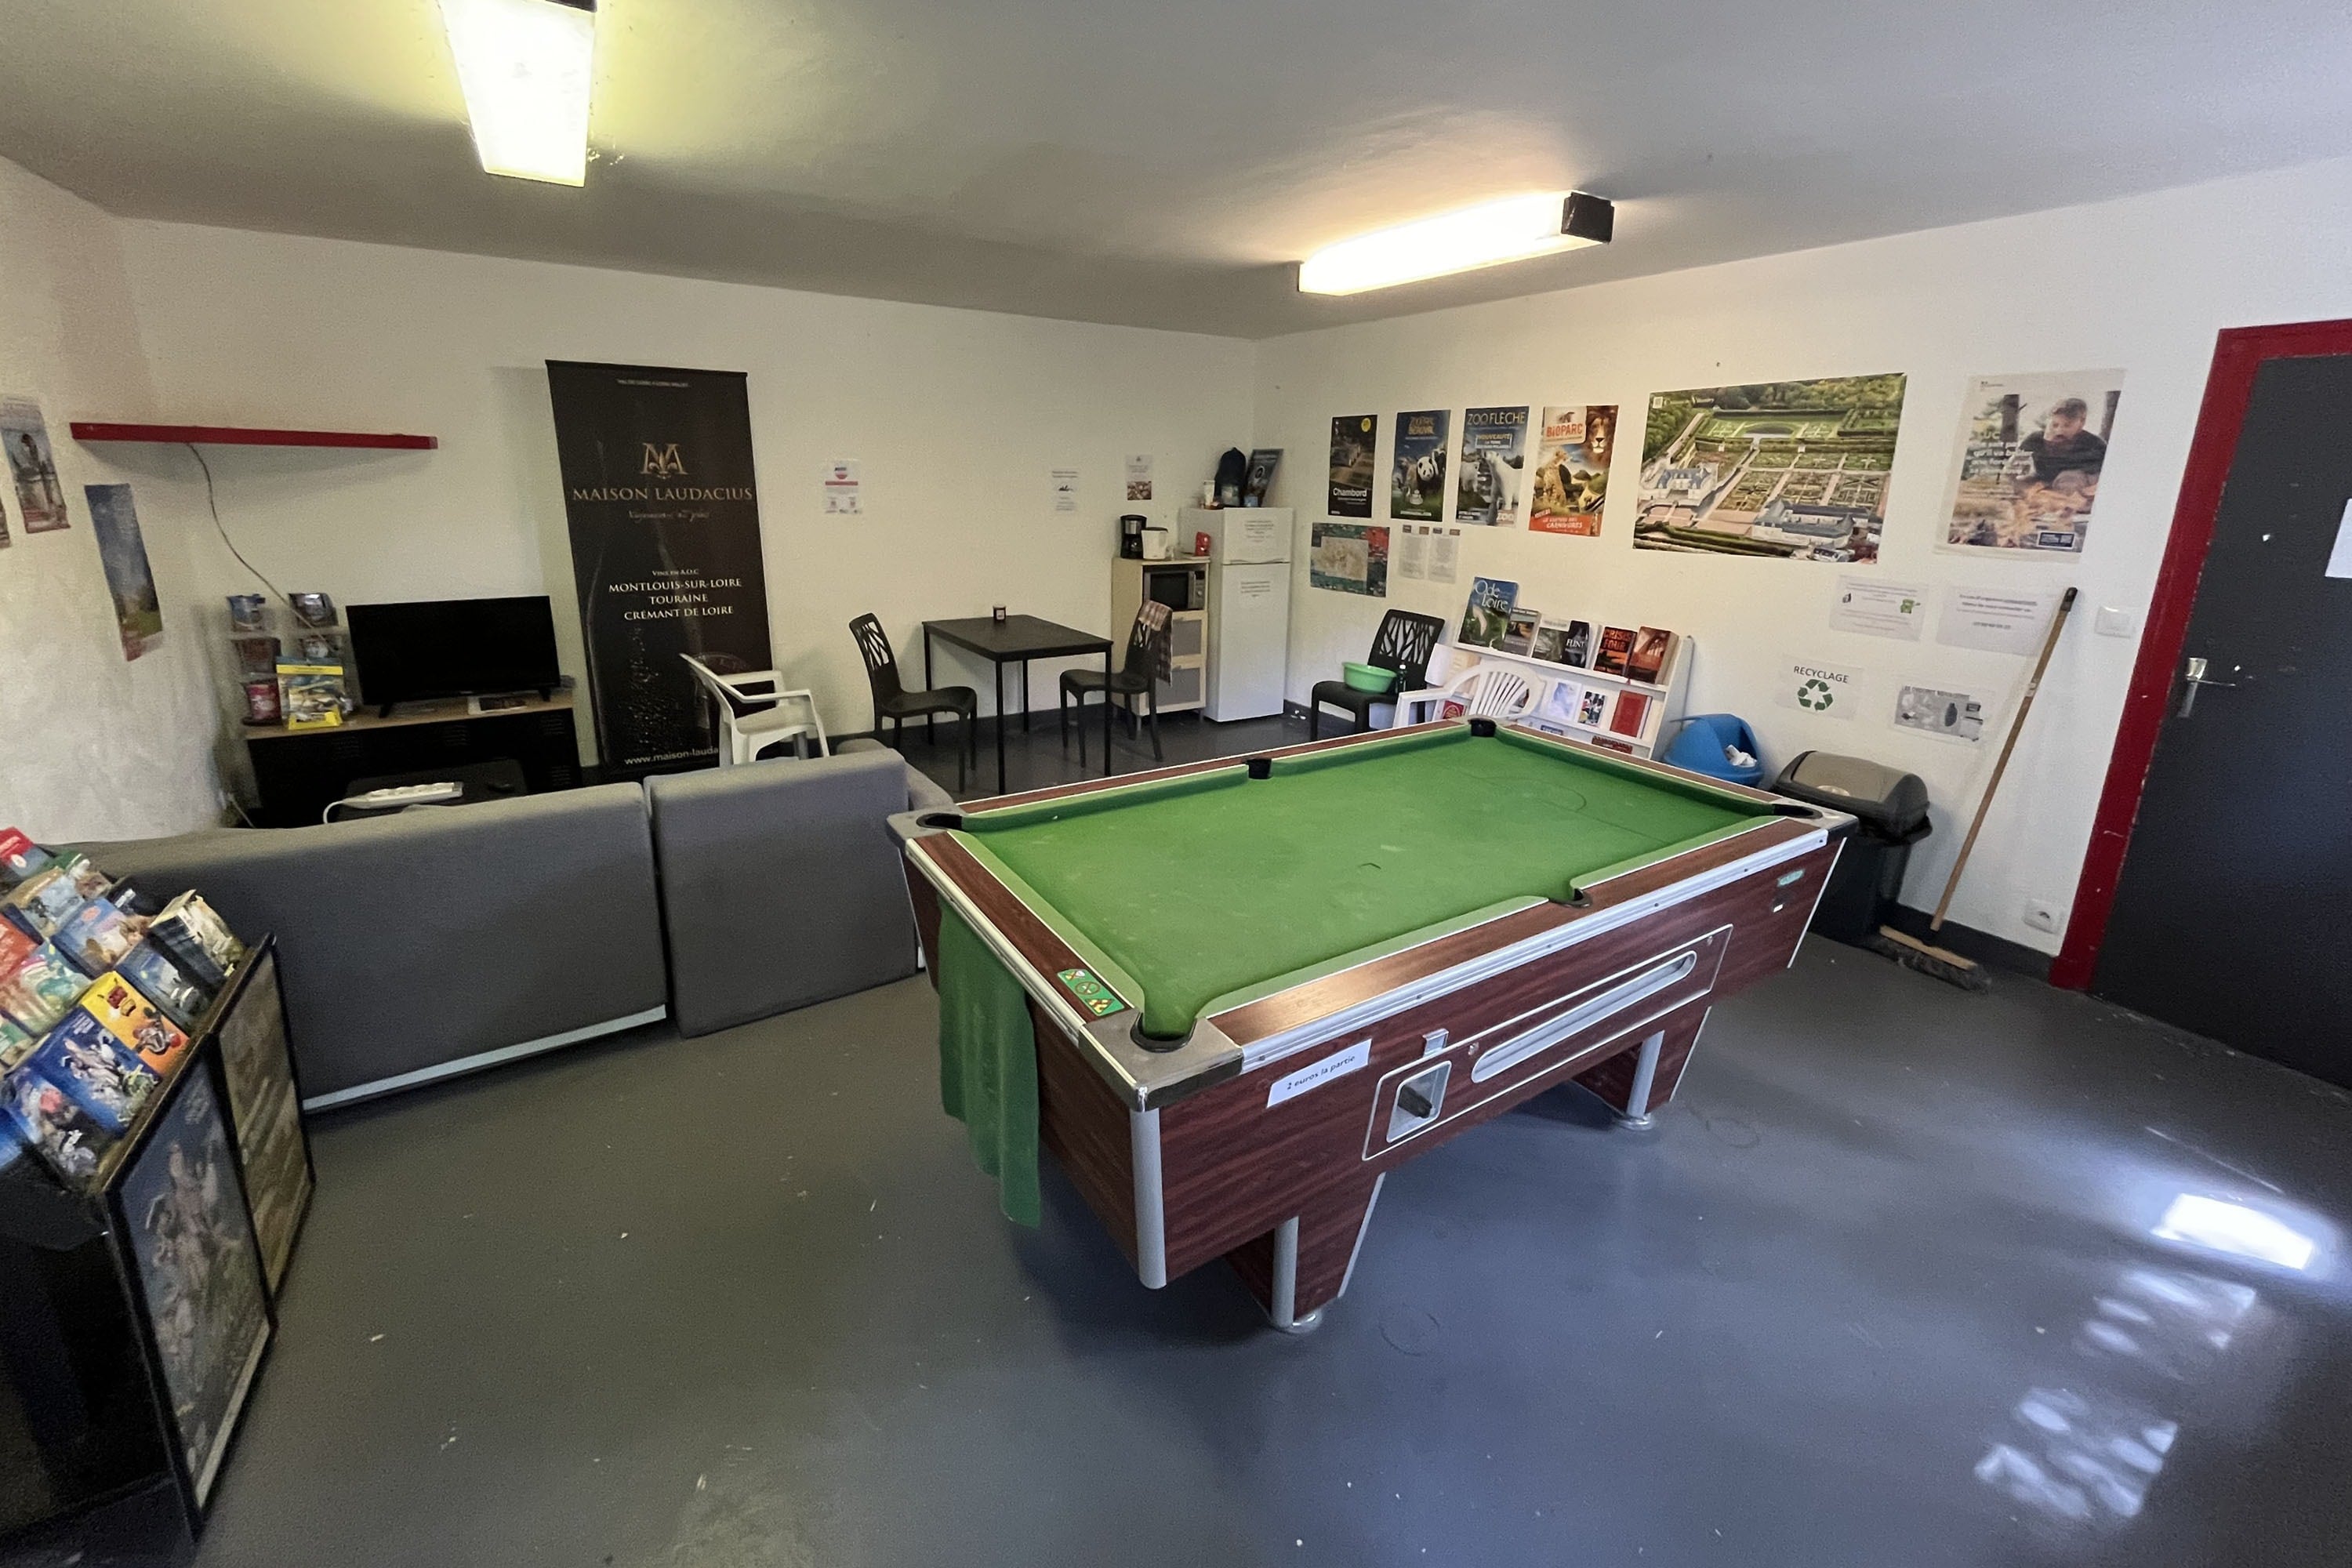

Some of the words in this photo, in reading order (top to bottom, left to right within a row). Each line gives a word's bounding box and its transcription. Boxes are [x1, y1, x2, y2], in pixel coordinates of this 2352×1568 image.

[572, 487, 649, 502] MAISON
[655, 487, 753, 502] LAUDACIUS
[1333, 487, 1368, 498] Chambord
[608, 578, 742, 593] MONTLOUIS-SUR-LOIRE
[649, 593, 708, 604] TOURAINE
[684, 608, 699, 617] DE
[702, 605, 734, 616] LOIRE
[1793, 665, 1849, 684] RECYCLAGE
[1294, 1073, 1319, 1087] euros
[1330, 1055, 1356, 1073] partie
